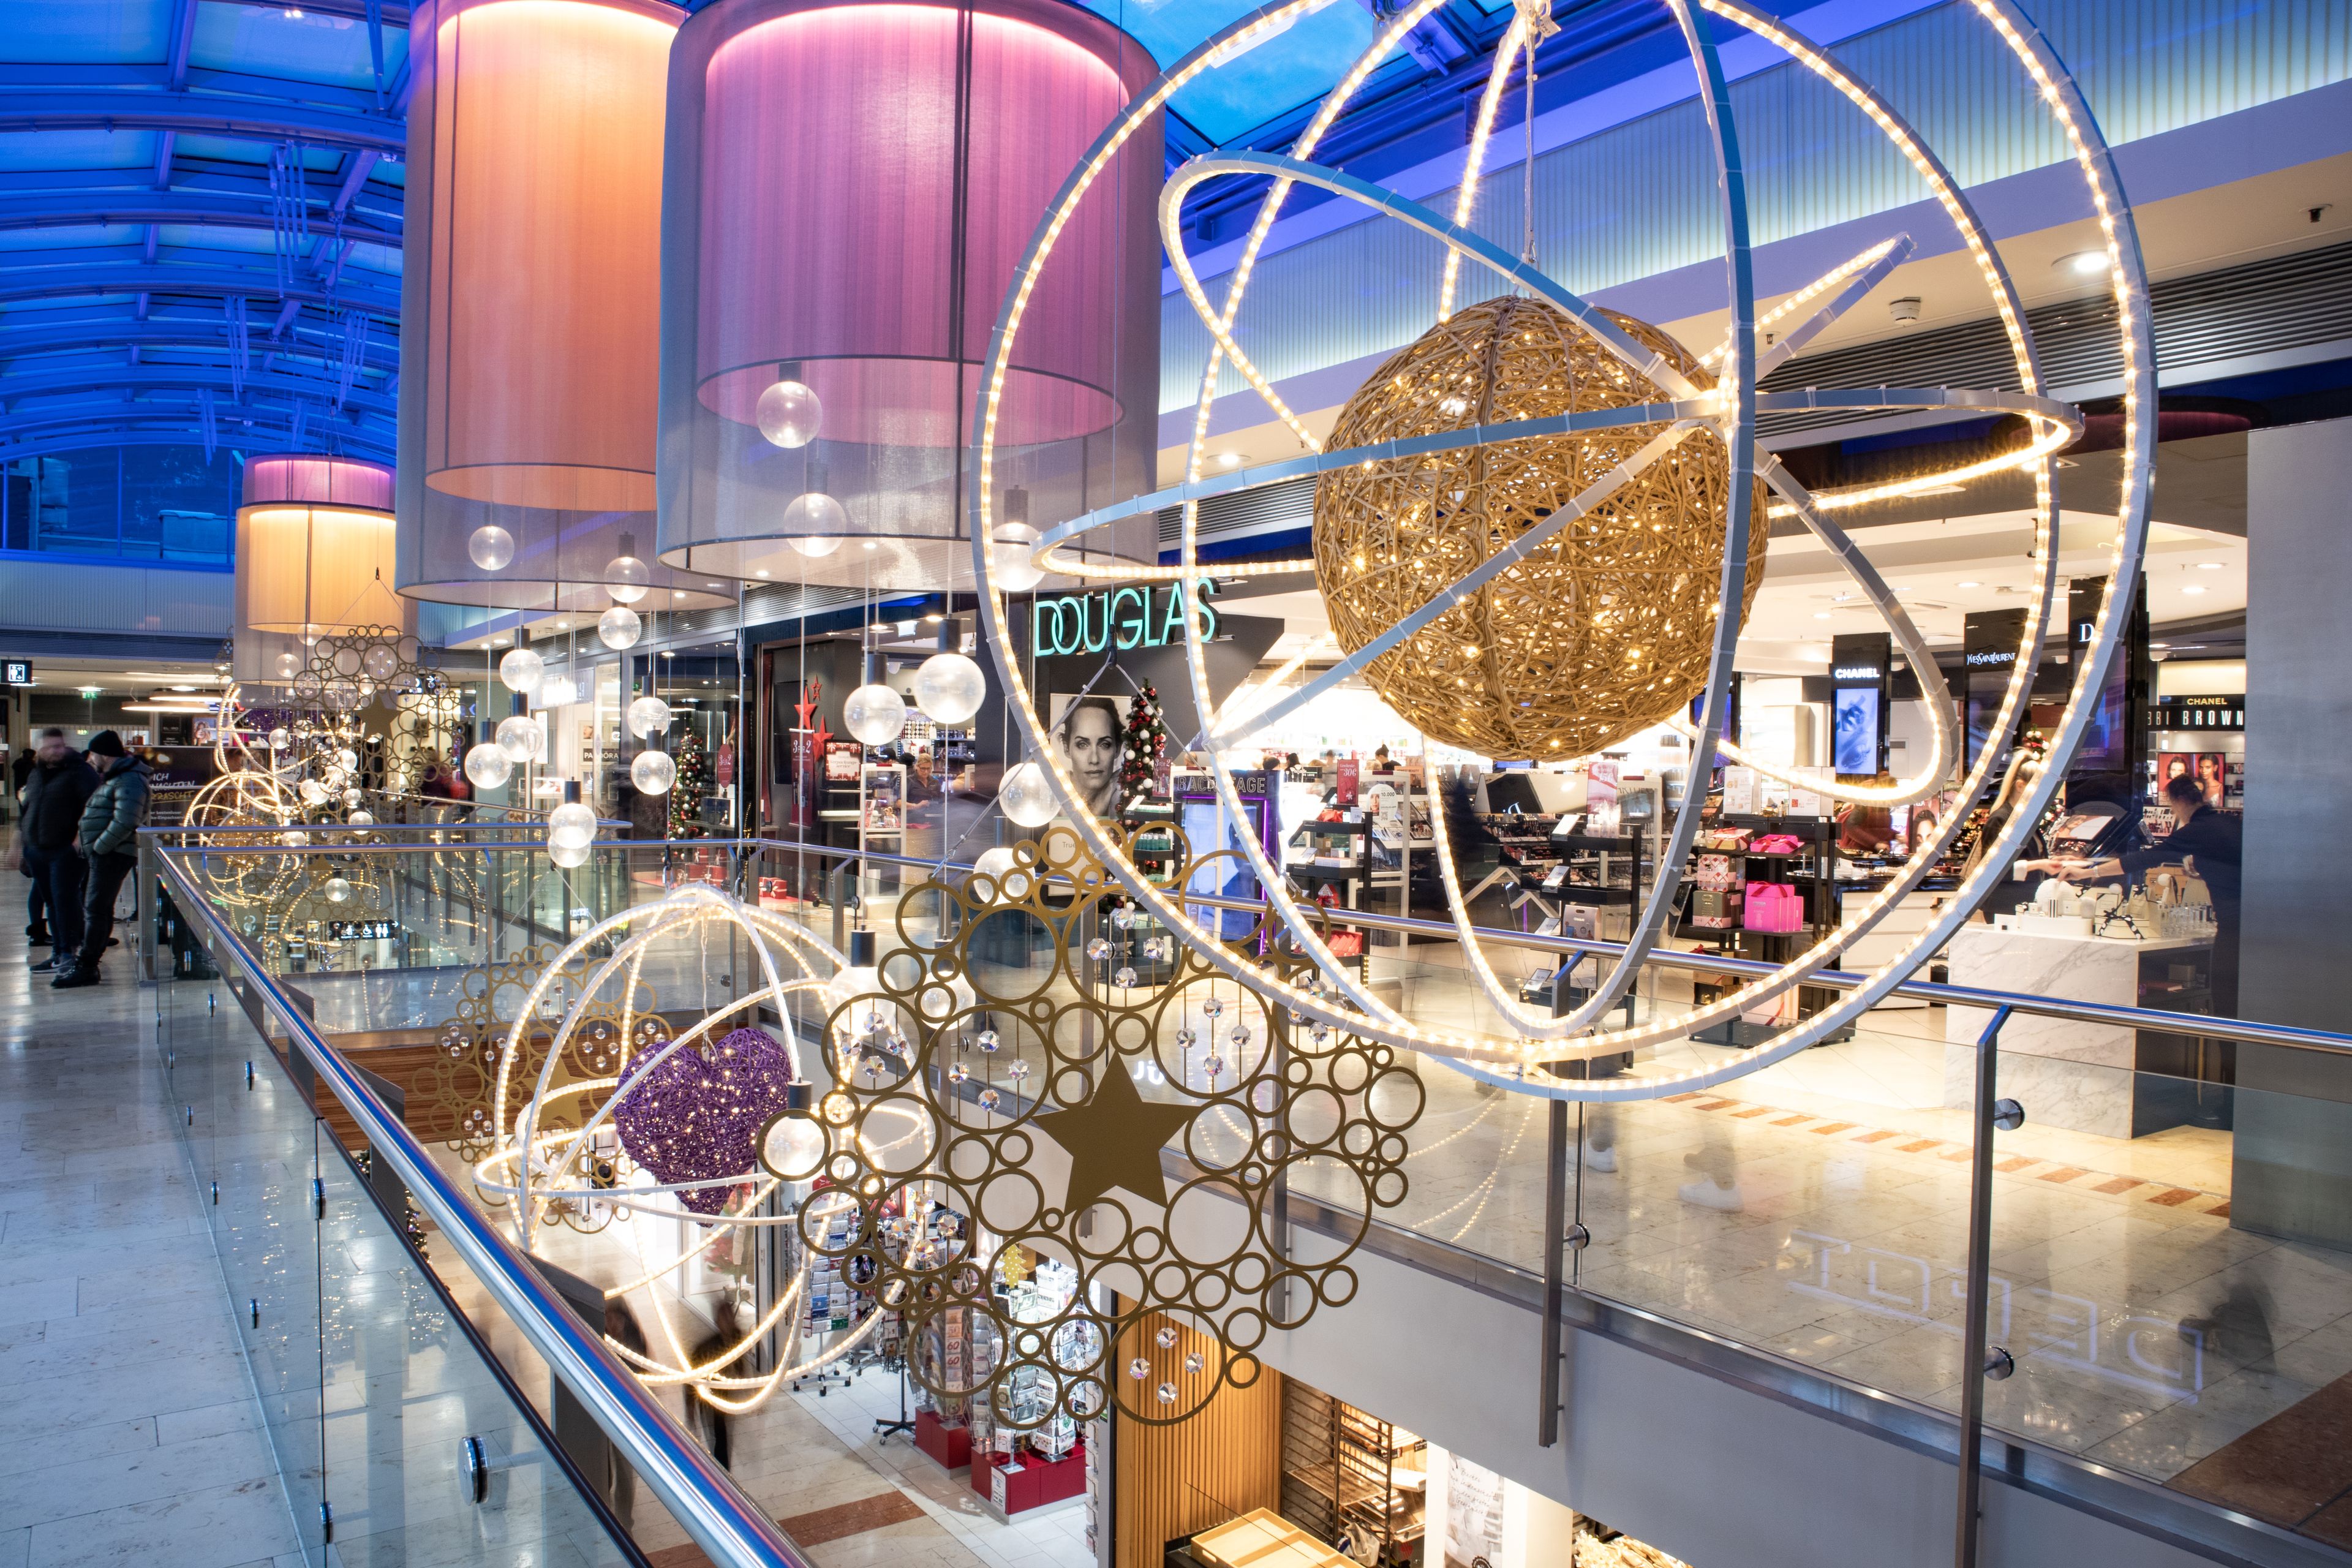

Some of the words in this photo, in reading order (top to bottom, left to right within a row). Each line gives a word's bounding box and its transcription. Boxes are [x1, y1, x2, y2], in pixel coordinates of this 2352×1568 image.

[1035, 578, 1216, 657] DOUGLAS
[1835, 668, 1880, 679] CHANEL
[2182, 710, 2244, 726] BROWN
